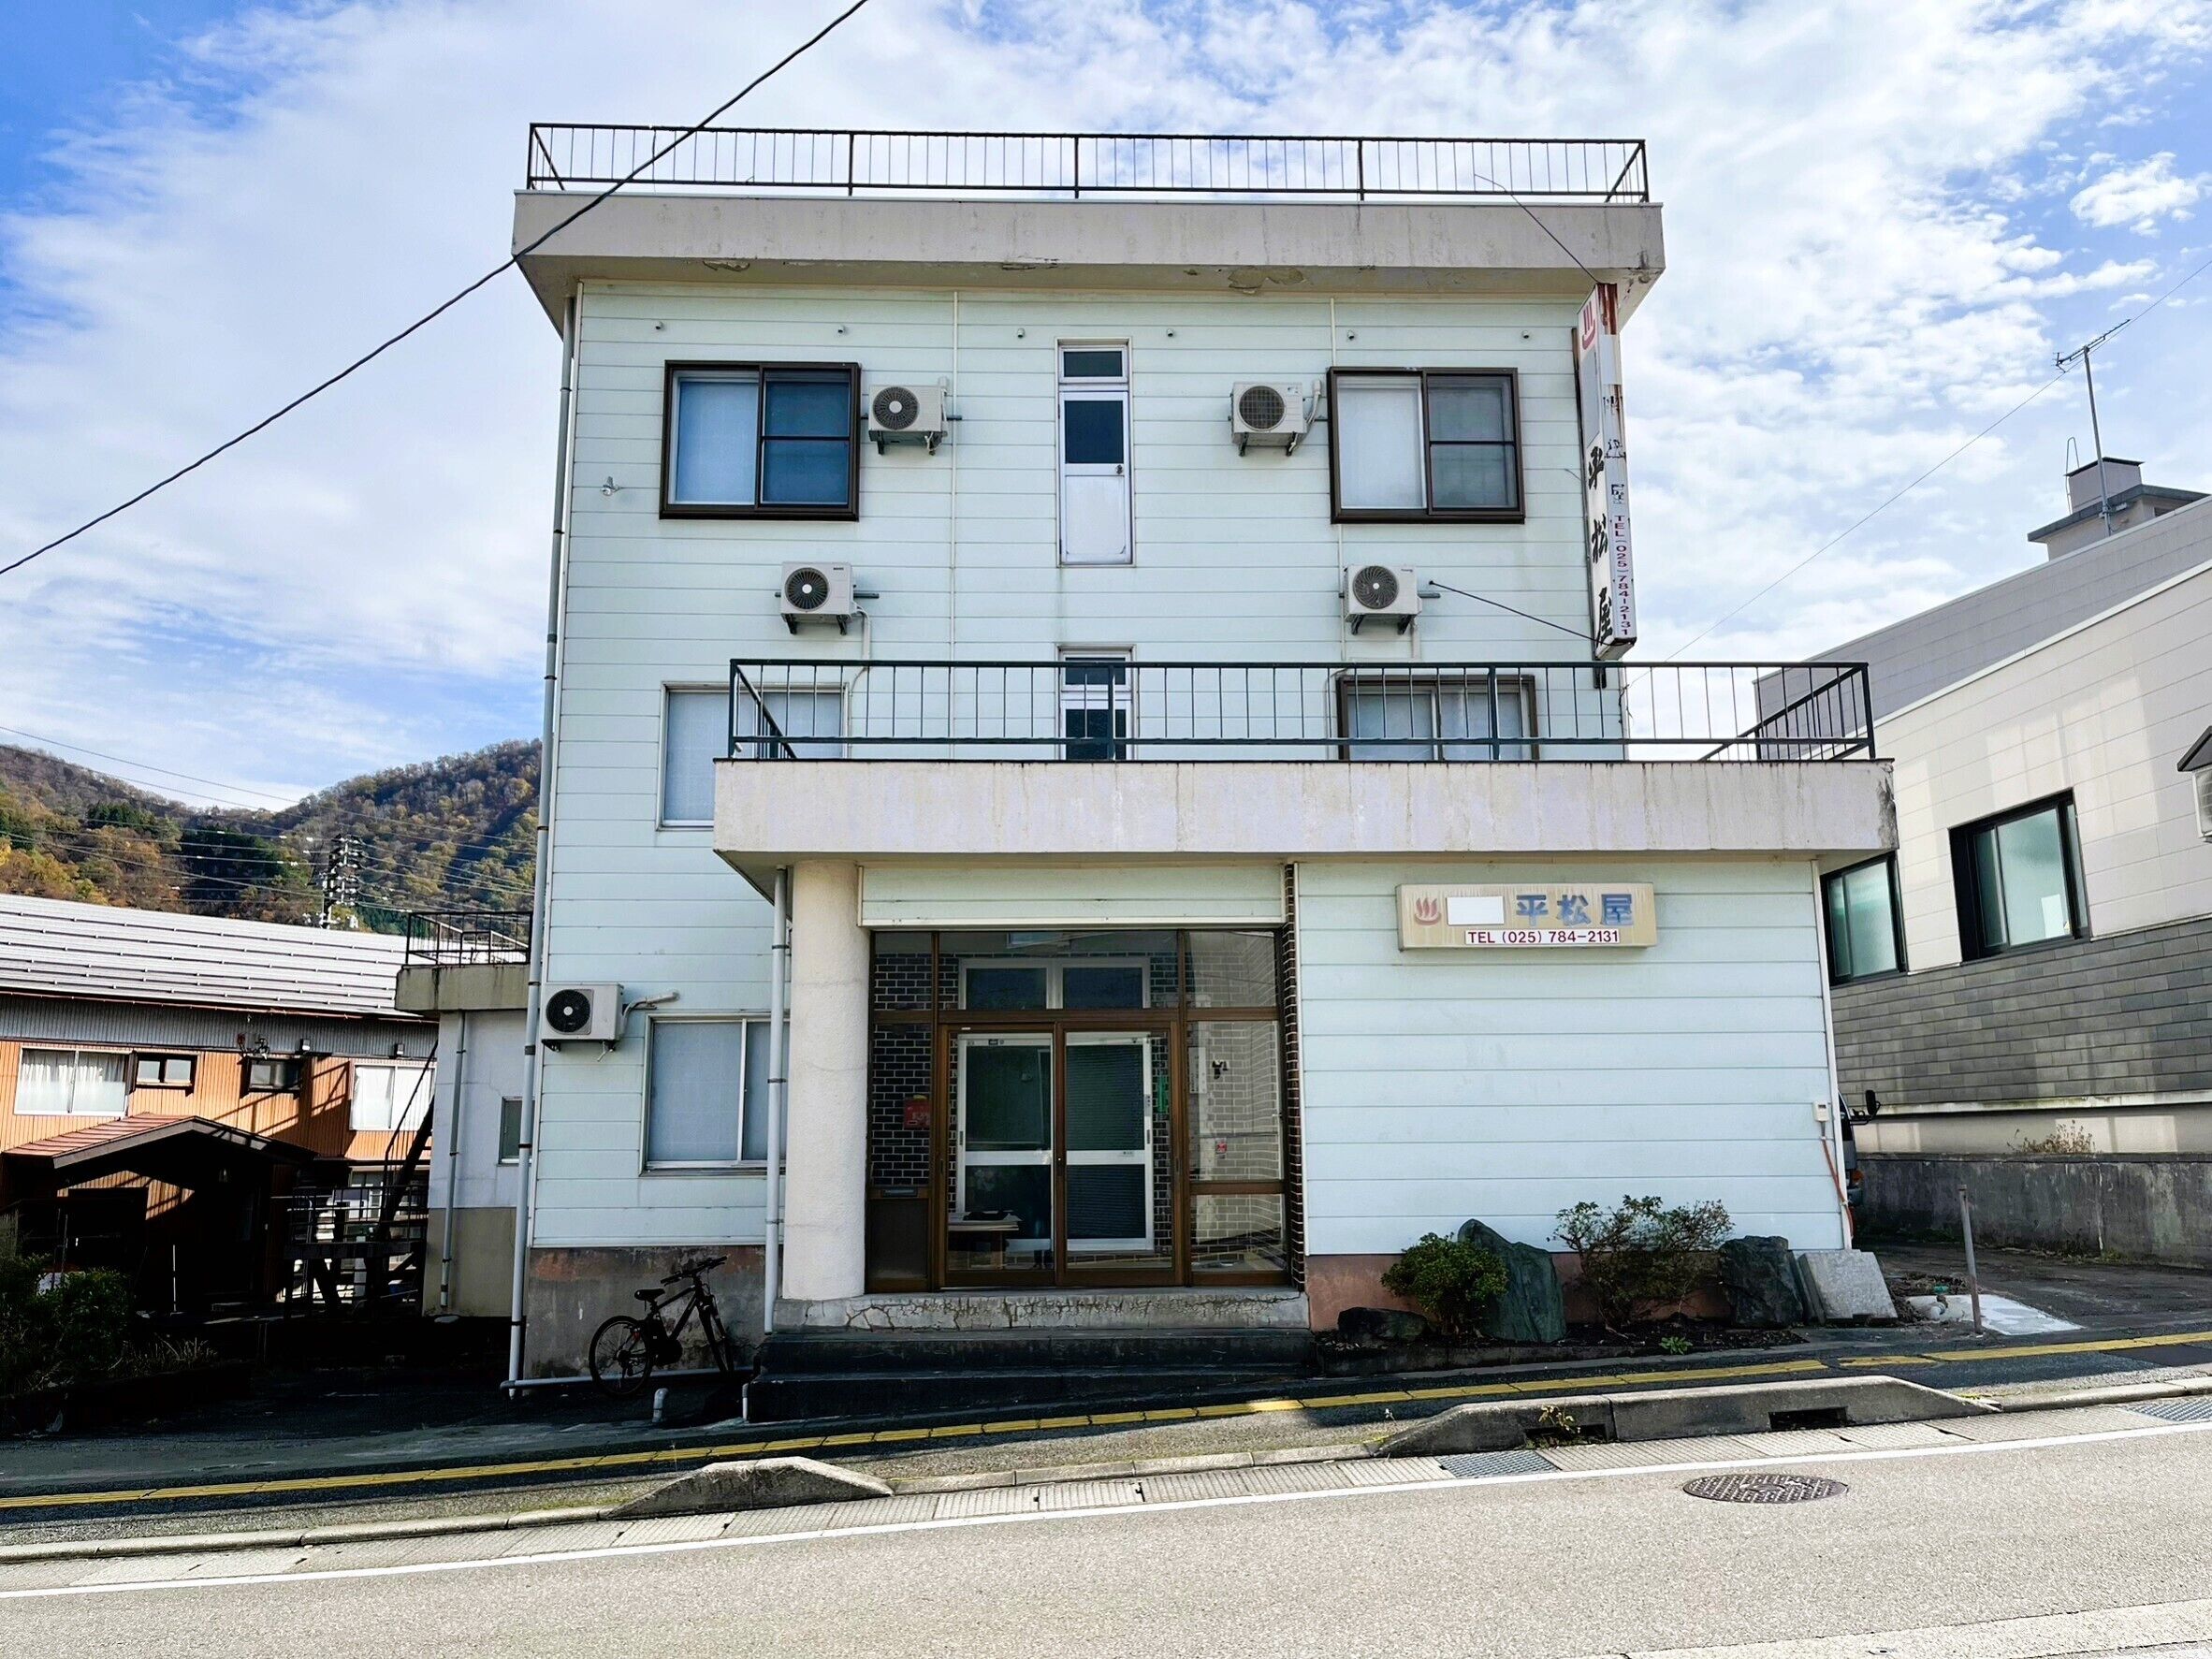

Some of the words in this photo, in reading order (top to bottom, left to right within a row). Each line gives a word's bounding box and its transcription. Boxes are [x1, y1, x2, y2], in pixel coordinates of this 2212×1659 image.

[1588, 445, 1613, 648] 平松屋
[1515, 894, 1635, 926] 平松屋
[1468, 932, 1495, 943] TEL
[1502, 931, 1542, 944] (025)
[1550, 930, 1619, 943] 784-2131
